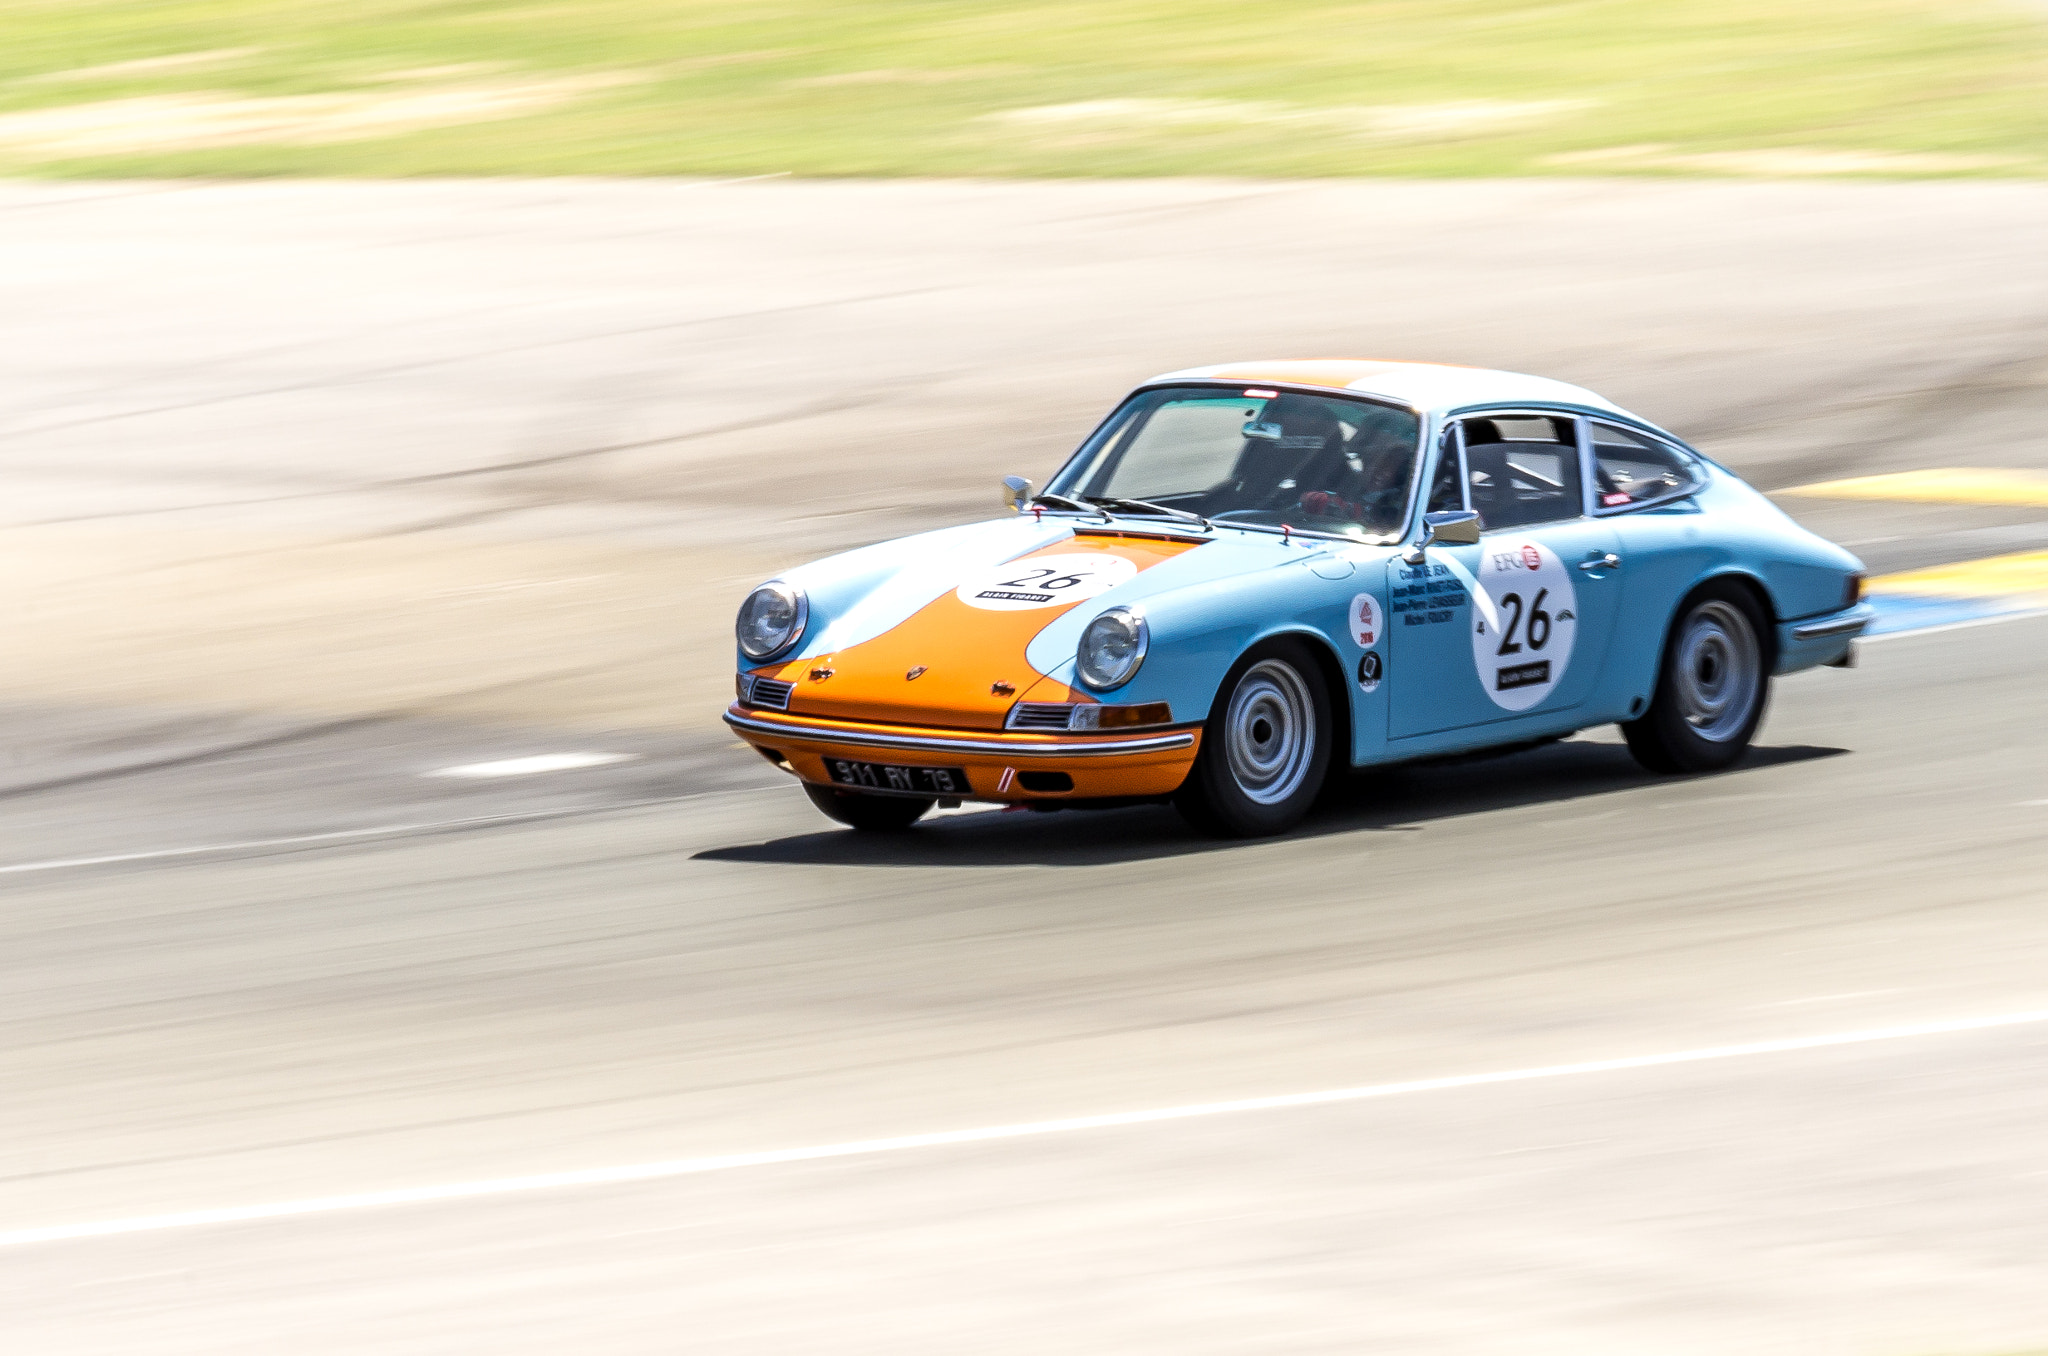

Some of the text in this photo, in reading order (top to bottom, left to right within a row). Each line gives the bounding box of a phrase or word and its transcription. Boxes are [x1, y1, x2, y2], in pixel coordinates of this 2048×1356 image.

[1492, 551, 1524, 571] EFG
[996, 569, 1094, 590] 26
[1495, 587, 1552, 656] 26
[836, 760, 956, 792] 911 RY 79
